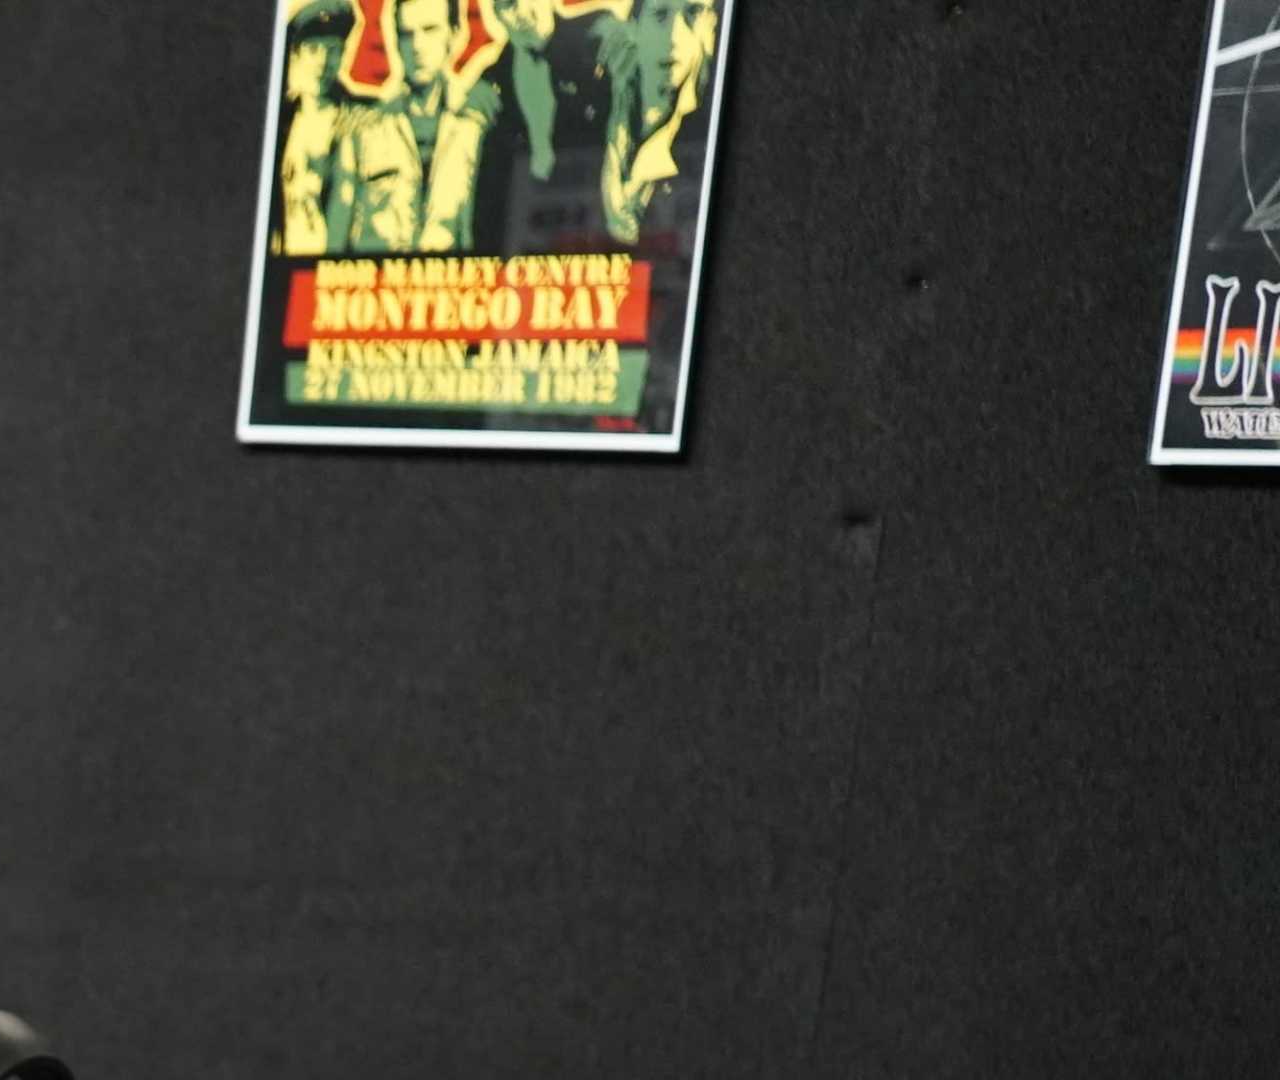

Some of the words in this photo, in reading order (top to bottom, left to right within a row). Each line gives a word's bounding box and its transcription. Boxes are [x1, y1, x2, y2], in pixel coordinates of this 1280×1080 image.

[381, 256, 502, 289] MARLEY
[505, 253, 633, 288] CENTRE
[313, 286, 521, 332] MONTEGO
[530, 285, 627, 331] BAY
[307, 338, 466, 370] KINGSTON
[471, 338, 620, 371] JAMAICA
[349, 368, 525, 403] NOVEMBER
